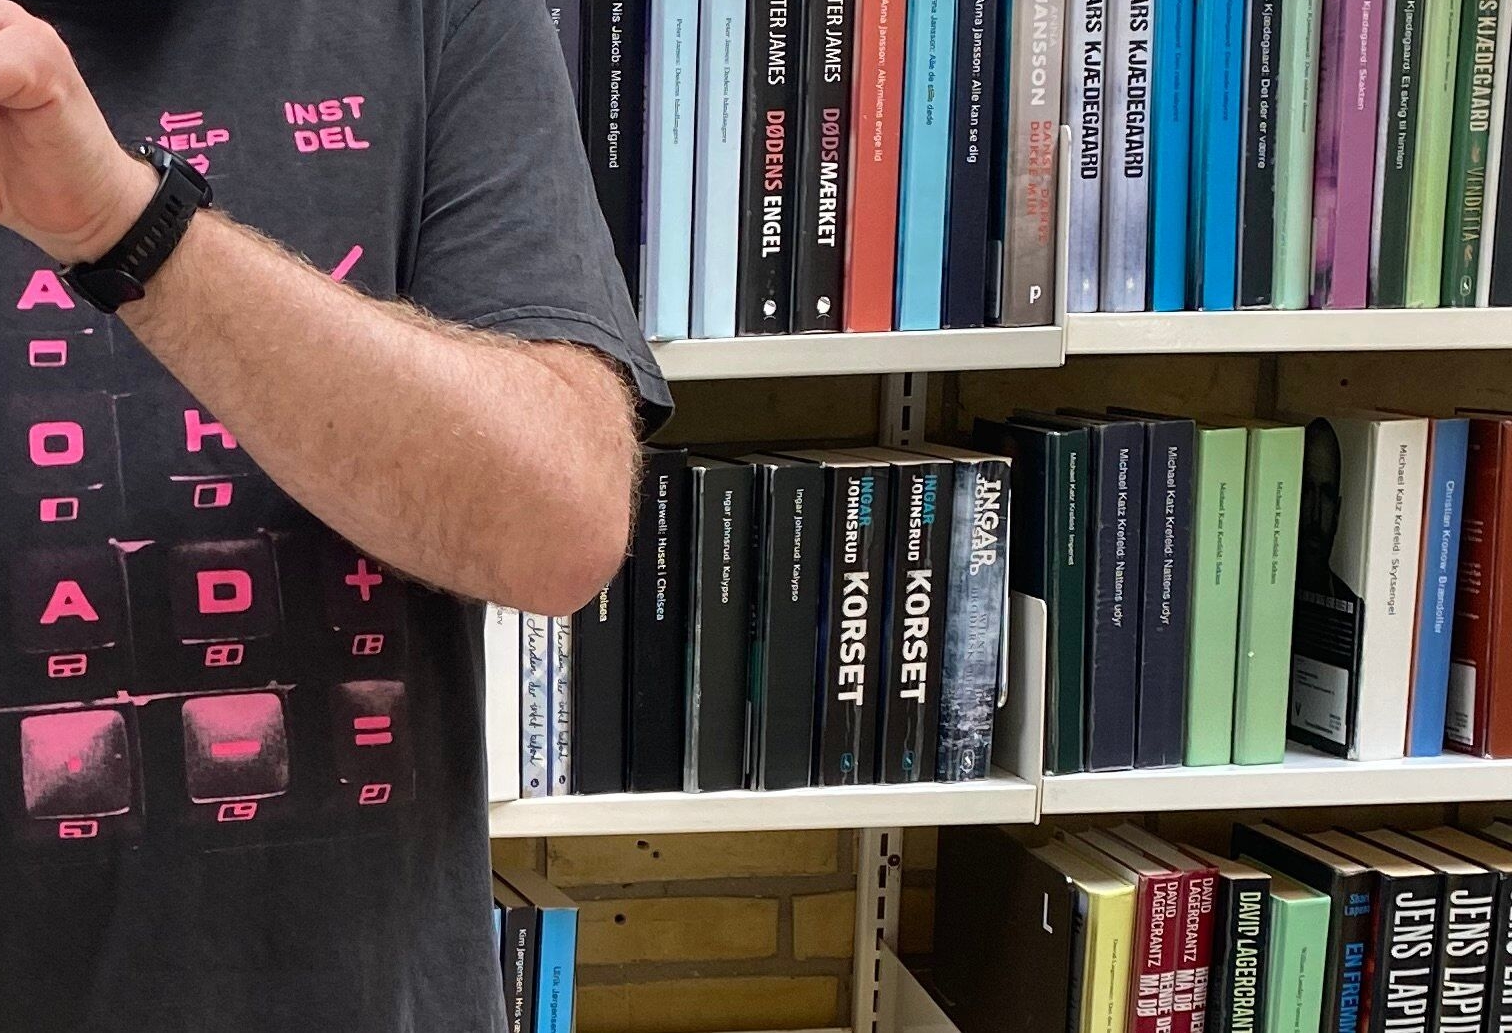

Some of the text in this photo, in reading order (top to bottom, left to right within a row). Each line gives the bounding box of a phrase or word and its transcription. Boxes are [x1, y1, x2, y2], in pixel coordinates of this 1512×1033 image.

[612, 2, 623, 24] Nis
[767, 31, 786, 86] JAMES
[823, 31, 841, 84] JAMES
[1469, 17, 1497, 132] KJÆDEGAARD
[284, 96, 365, 126] INST
[609, 70, 622, 119] Mørkets
[1081, 40, 1102, 180] KJÆDEGAARD
[1124, 39, 1148, 179] KJÆDEGAARD
[294, 126, 370, 153] DEL
[607, 121, 621, 169] afgrund
[762, 110, 786, 258] DØDENS ENGEL
[817, 108, 841, 248] DØDSMÆRKET
[1463, 165, 1485, 242] VENDETTA
[16, 269, 75, 309] A
[29, 421, 84, 466] O
[659, 475, 668, 495] Lisa
[859, 476, 874, 527] INGAR
[922, 474, 937, 525] INGAR
[844, 476, 861, 564] JOHNSRUD
[907, 474, 924, 562] JOHNSRUD
[657, 538, 667, 571] Huset
[40, 580, 99, 624] A
[197, 569, 252, 614] D
[655, 580, 666, 622] Chelsea
[838, 570, 870, 706] KORSET
[900, 569, 932, 704] KORSET
[1147, 882, 1166, 968] LAGERCRANTZ
[1166, 881, 1178, 918] DAVID
[1390, 891, 1437, 961] JENS
[1445, 888, 1493, 958] JENS
